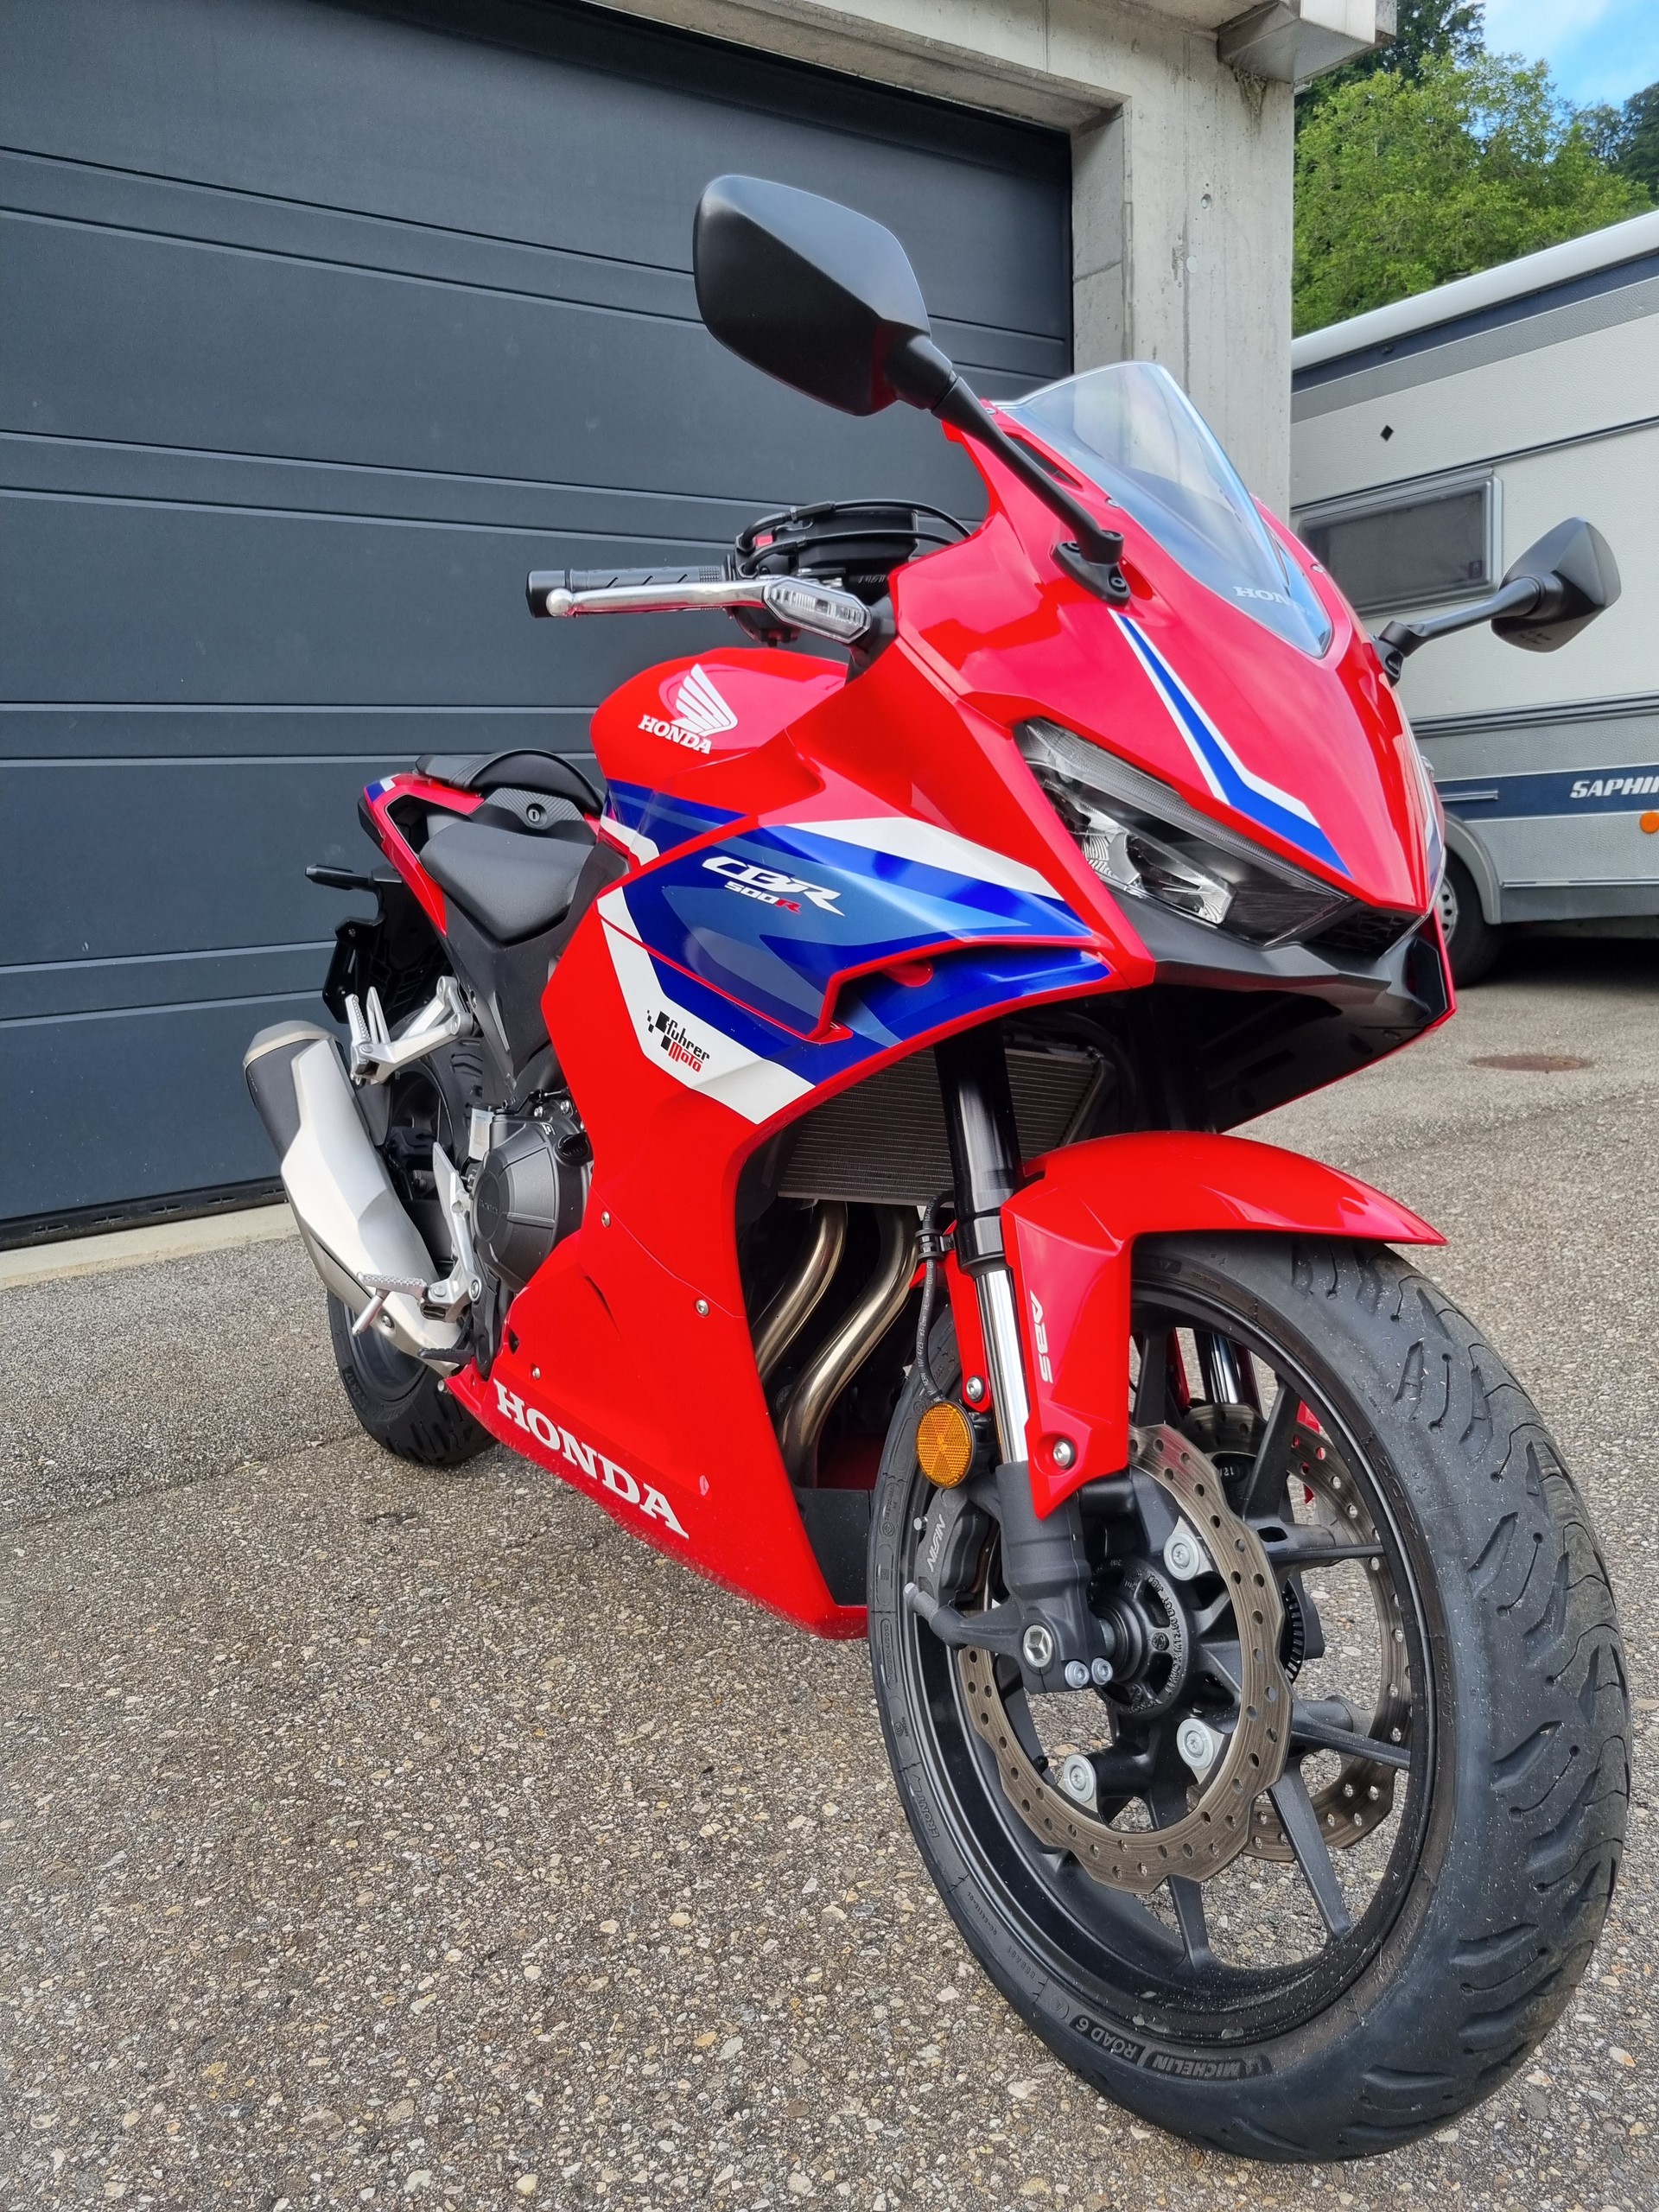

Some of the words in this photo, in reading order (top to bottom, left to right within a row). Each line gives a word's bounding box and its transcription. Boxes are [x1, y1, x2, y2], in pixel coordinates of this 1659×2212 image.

[638, 715, 712, 754] HONDA
[702, 856, 845, 916] CBR
[725, 881, 801, 914] 500R
[1030, 1290, 1053, 1383] ABS
[493, 1378, 689, 1539] HONDA
[918, 1795, 940, 1839] FRONT
[1075, 2017, 1089, 2031] 6
[1090, 2025, 1137, 2060] ROAD
[1152, 2053, 1241, 2077] MICHELIN
